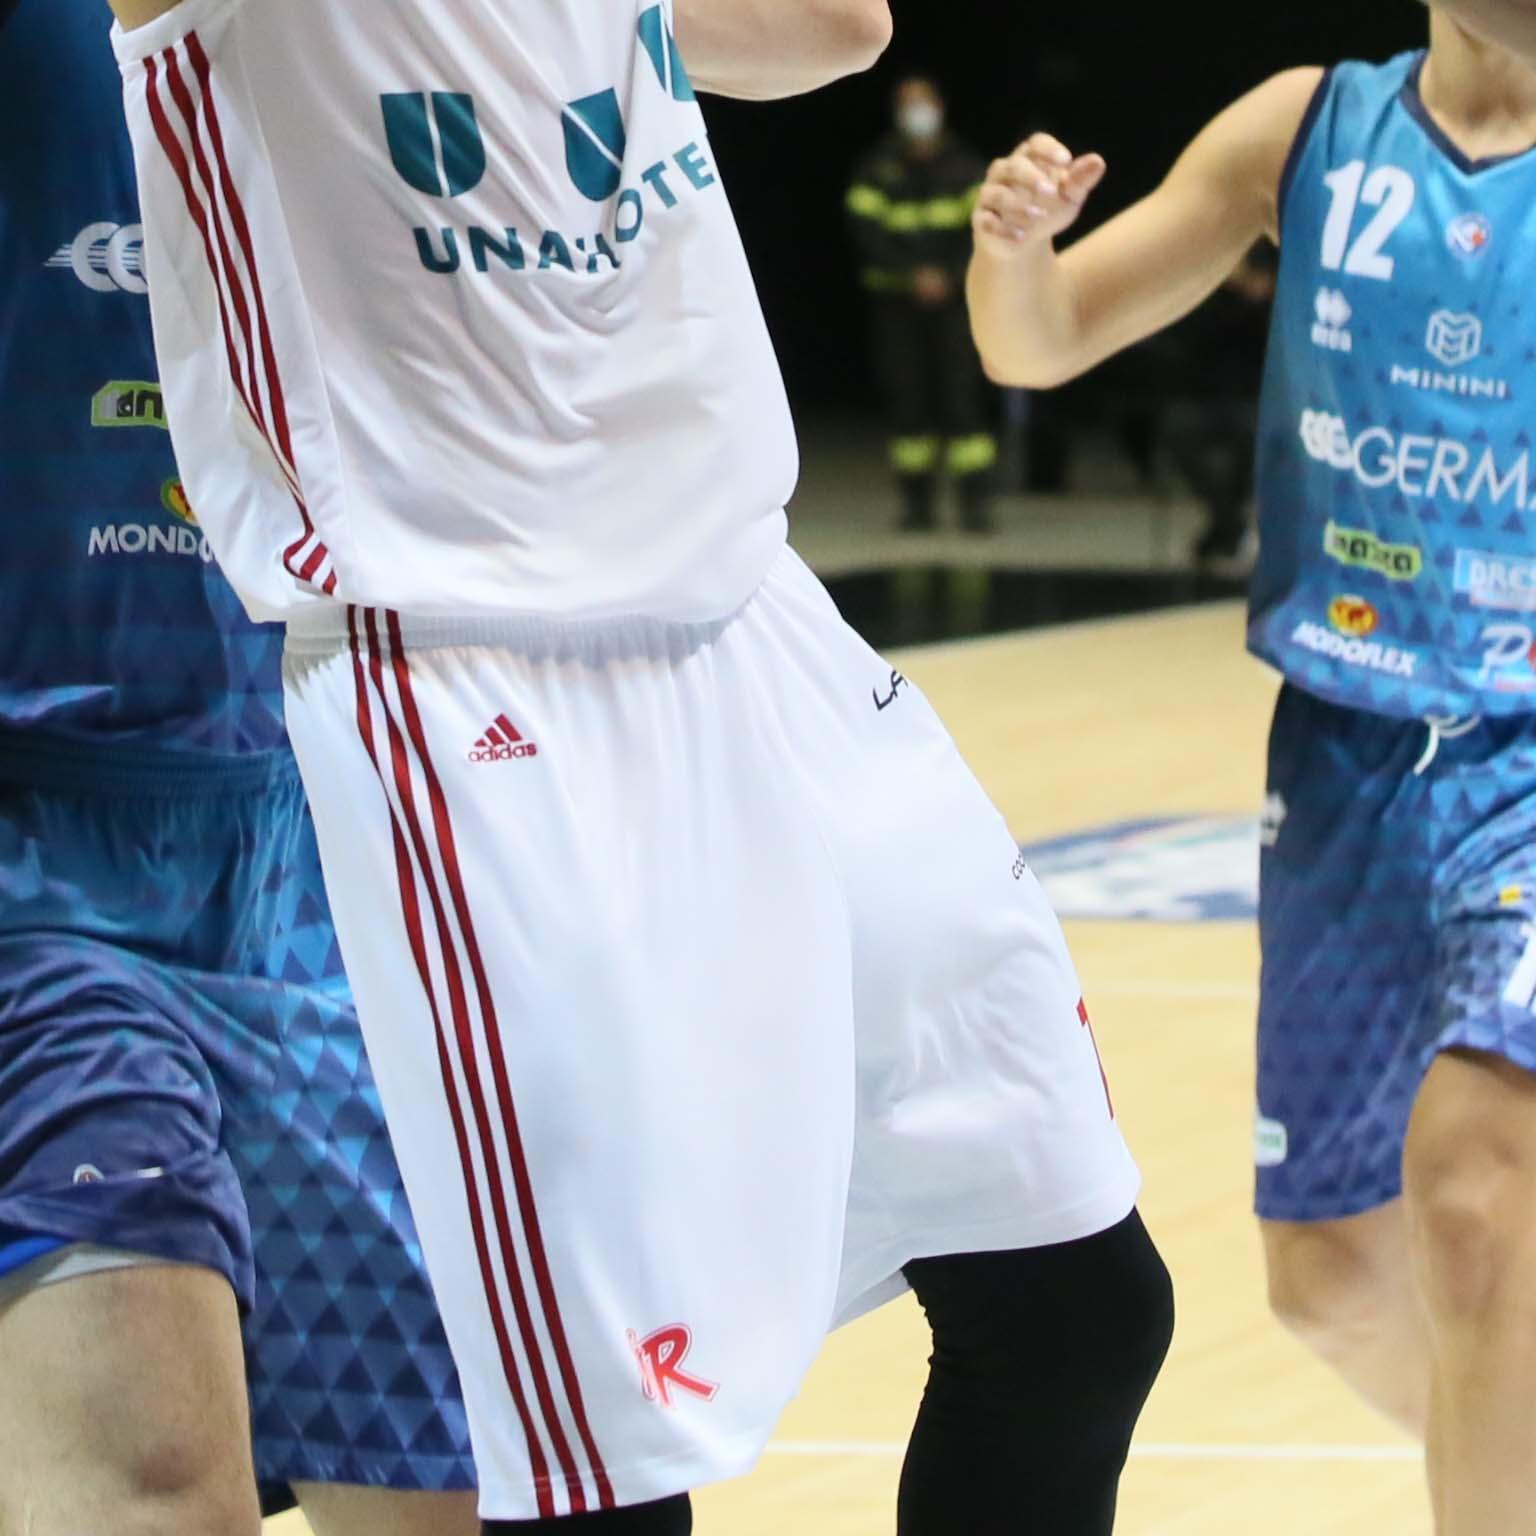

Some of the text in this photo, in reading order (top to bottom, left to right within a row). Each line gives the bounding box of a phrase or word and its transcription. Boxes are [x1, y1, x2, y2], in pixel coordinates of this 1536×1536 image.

[1320, 160, 1415, 281] 12
[1390, 364, 1508, 398] MININI
[468, 743, 537, 762] adidas
